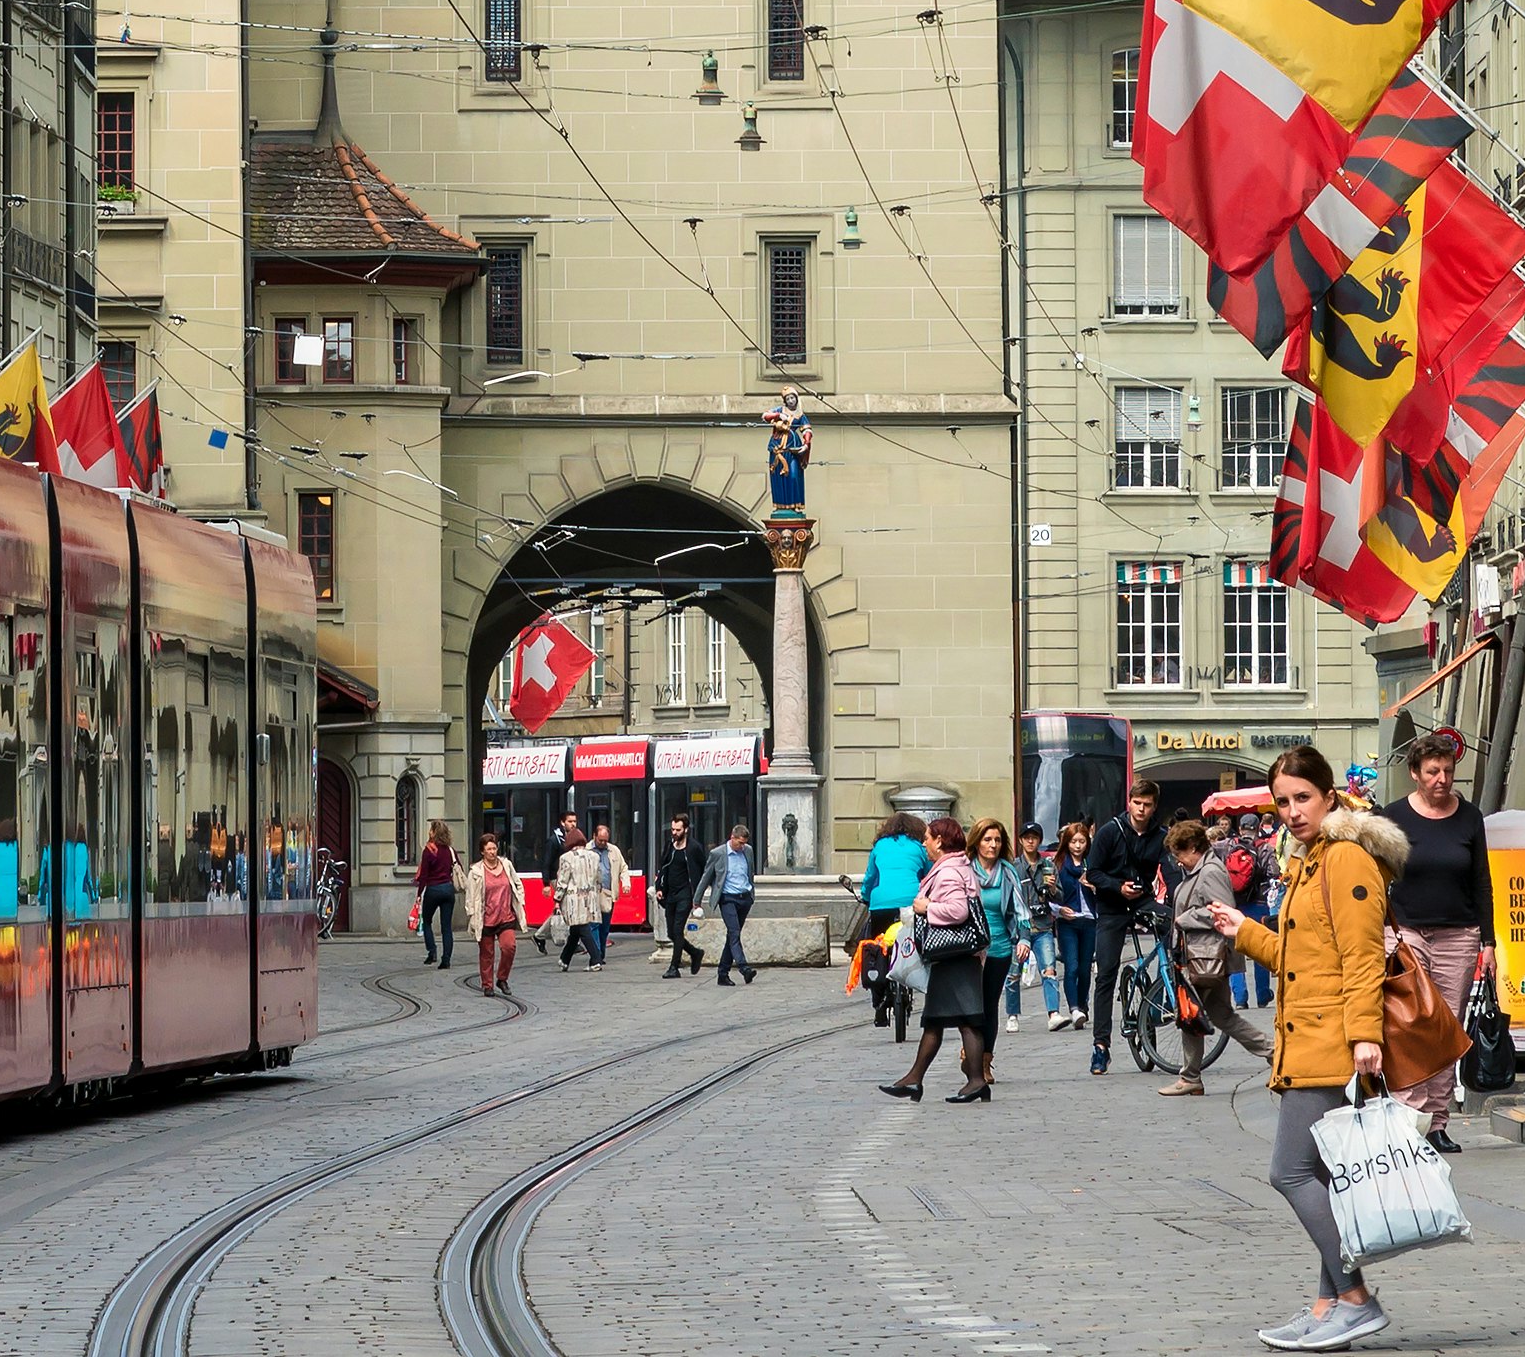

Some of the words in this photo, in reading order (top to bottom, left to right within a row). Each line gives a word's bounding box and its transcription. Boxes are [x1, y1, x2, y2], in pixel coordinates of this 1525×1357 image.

[1032, 530, 1050, 542] 20
[1157, 732, 1186, 750] Da
[1191, 731, 1243, 750] Vinci
[1251, 734, 1313, 747] PASTERIA
[503, 753, 560, 778] KEHRSATZ
[712, 748, 752, 769] KEHRSATZ
